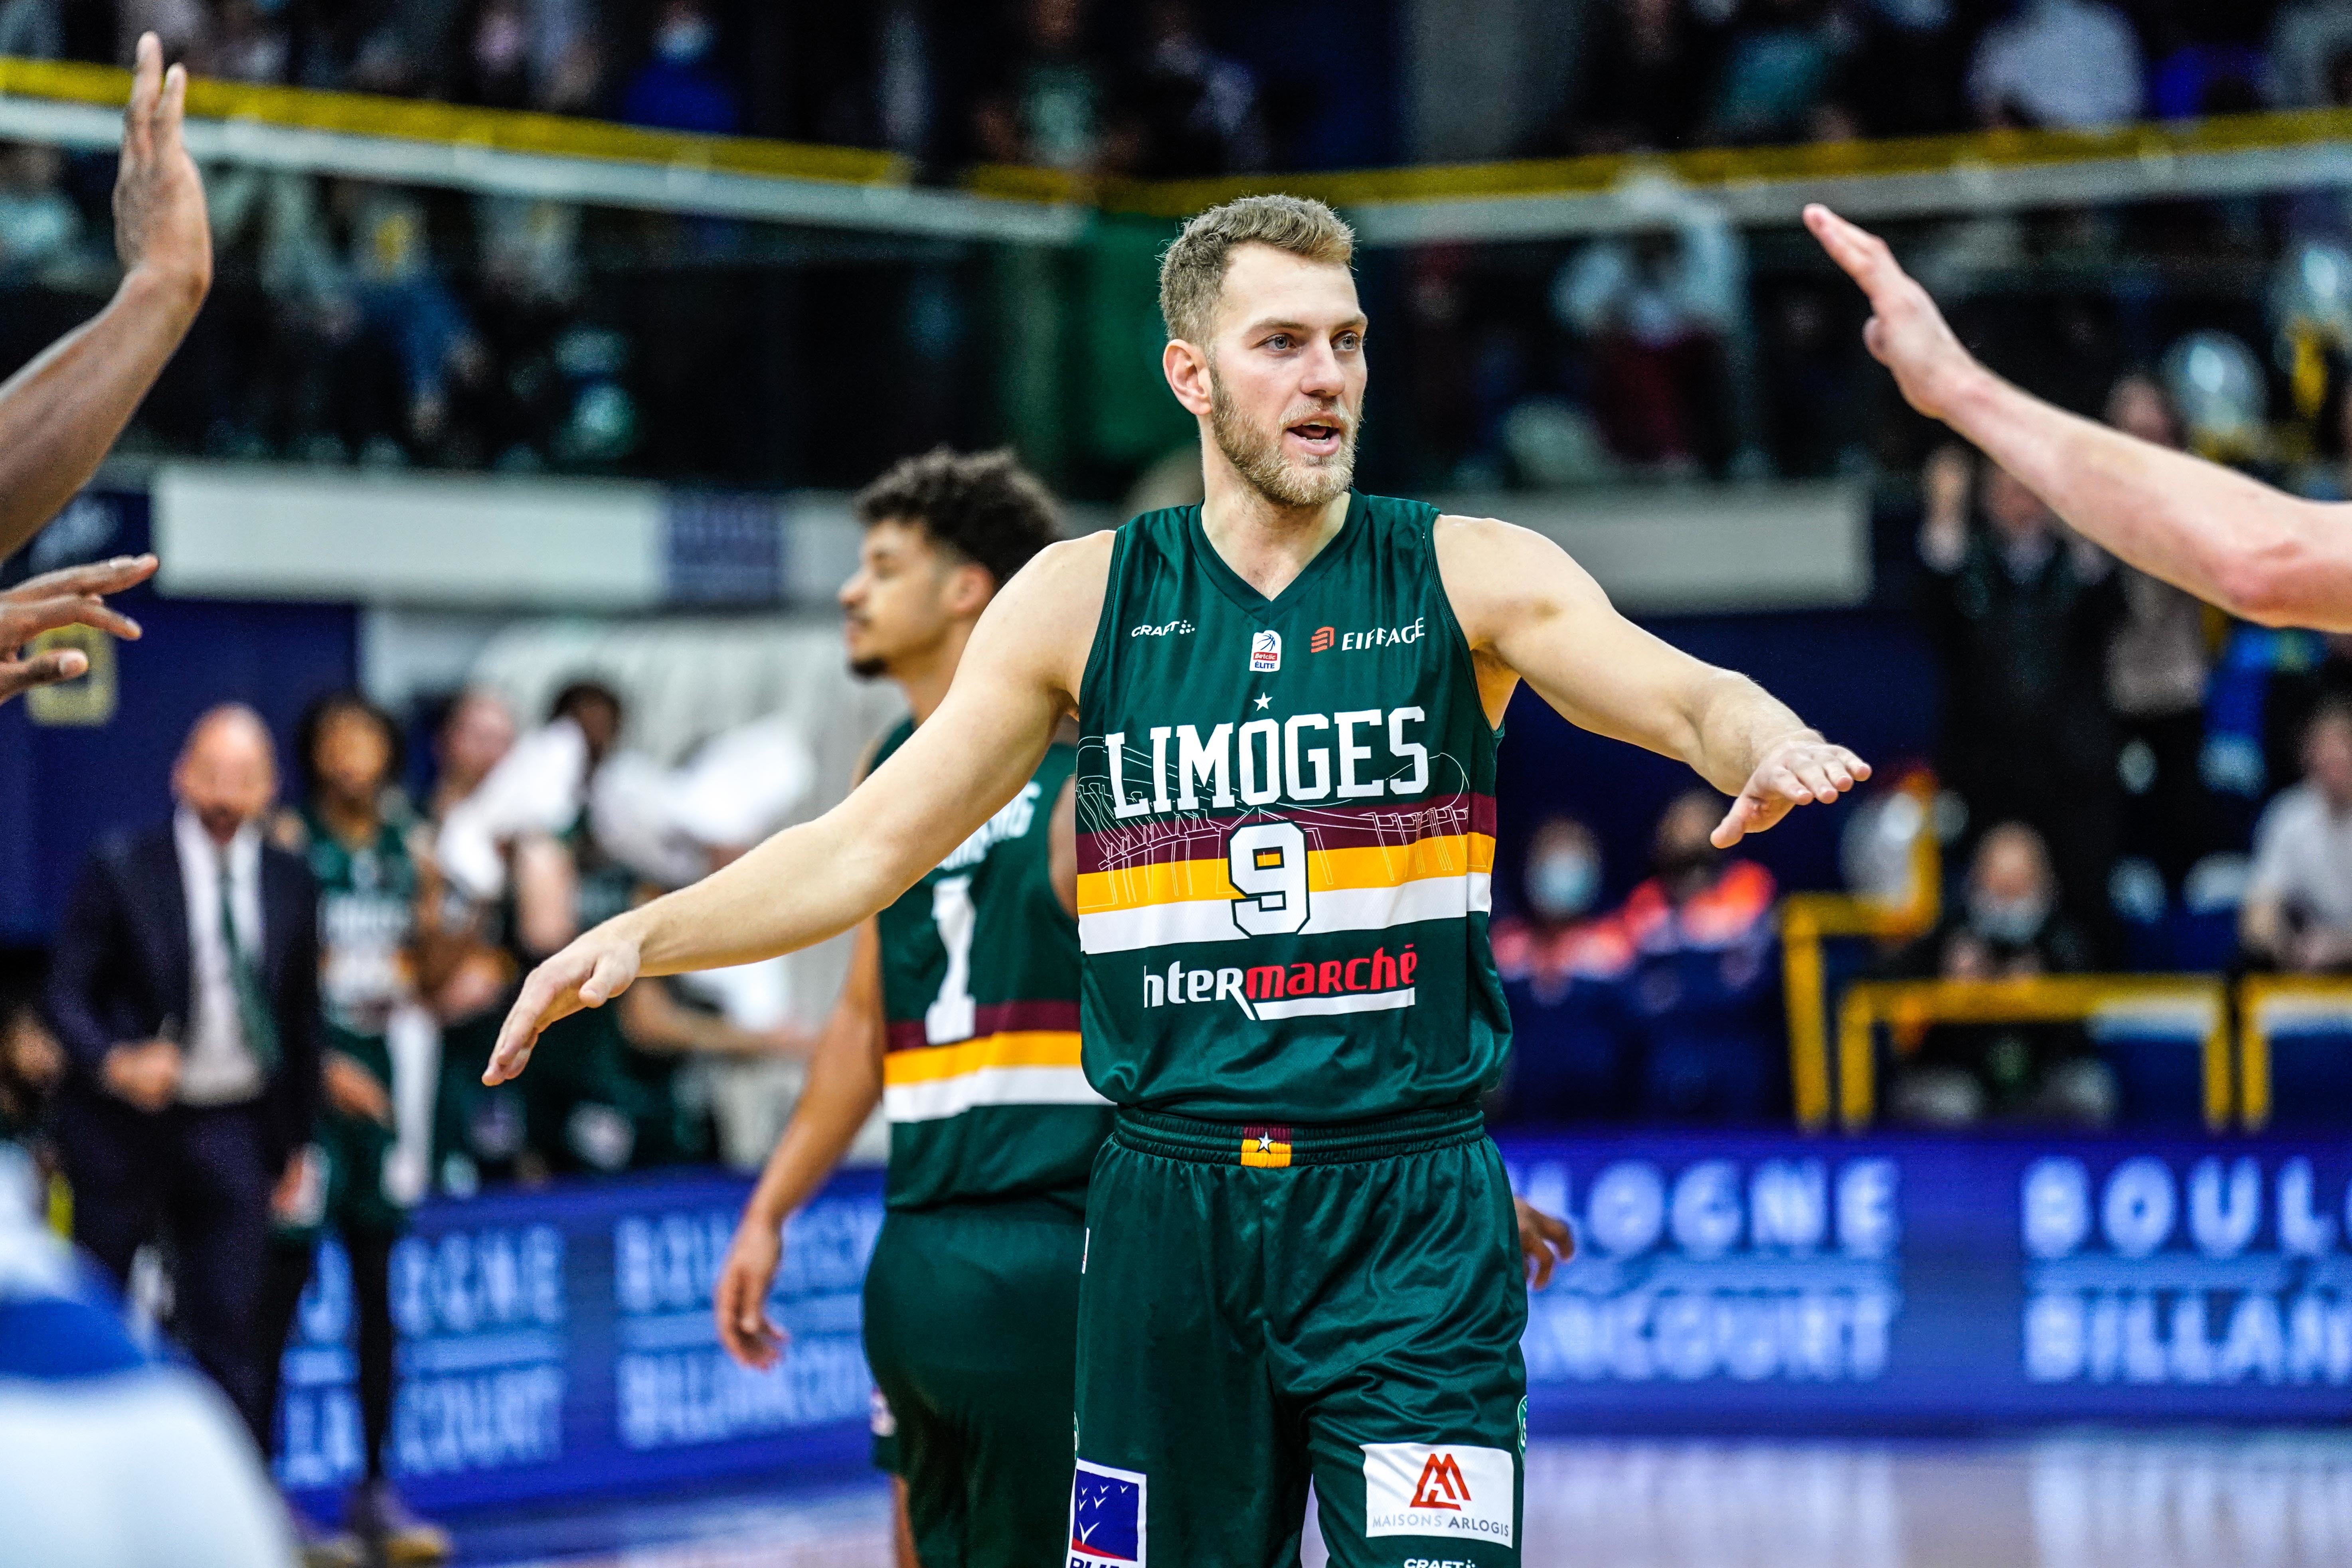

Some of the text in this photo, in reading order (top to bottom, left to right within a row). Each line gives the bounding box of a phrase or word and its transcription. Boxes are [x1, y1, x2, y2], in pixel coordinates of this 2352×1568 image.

[1131, 621, 1180, 638] CRAFT
[1342, 617, 1425, 651] EIFFAGE
[1255, 661, 1275, 669] ÉLITE
[1105, 706, 1429, 820] LIMOGES
[1228, 820, 1310, 938] 9
[2020, 1155, 2352, 1259] BOUL
[1372, 1514, 1509, 1537] MAISONS ARLOGIS
